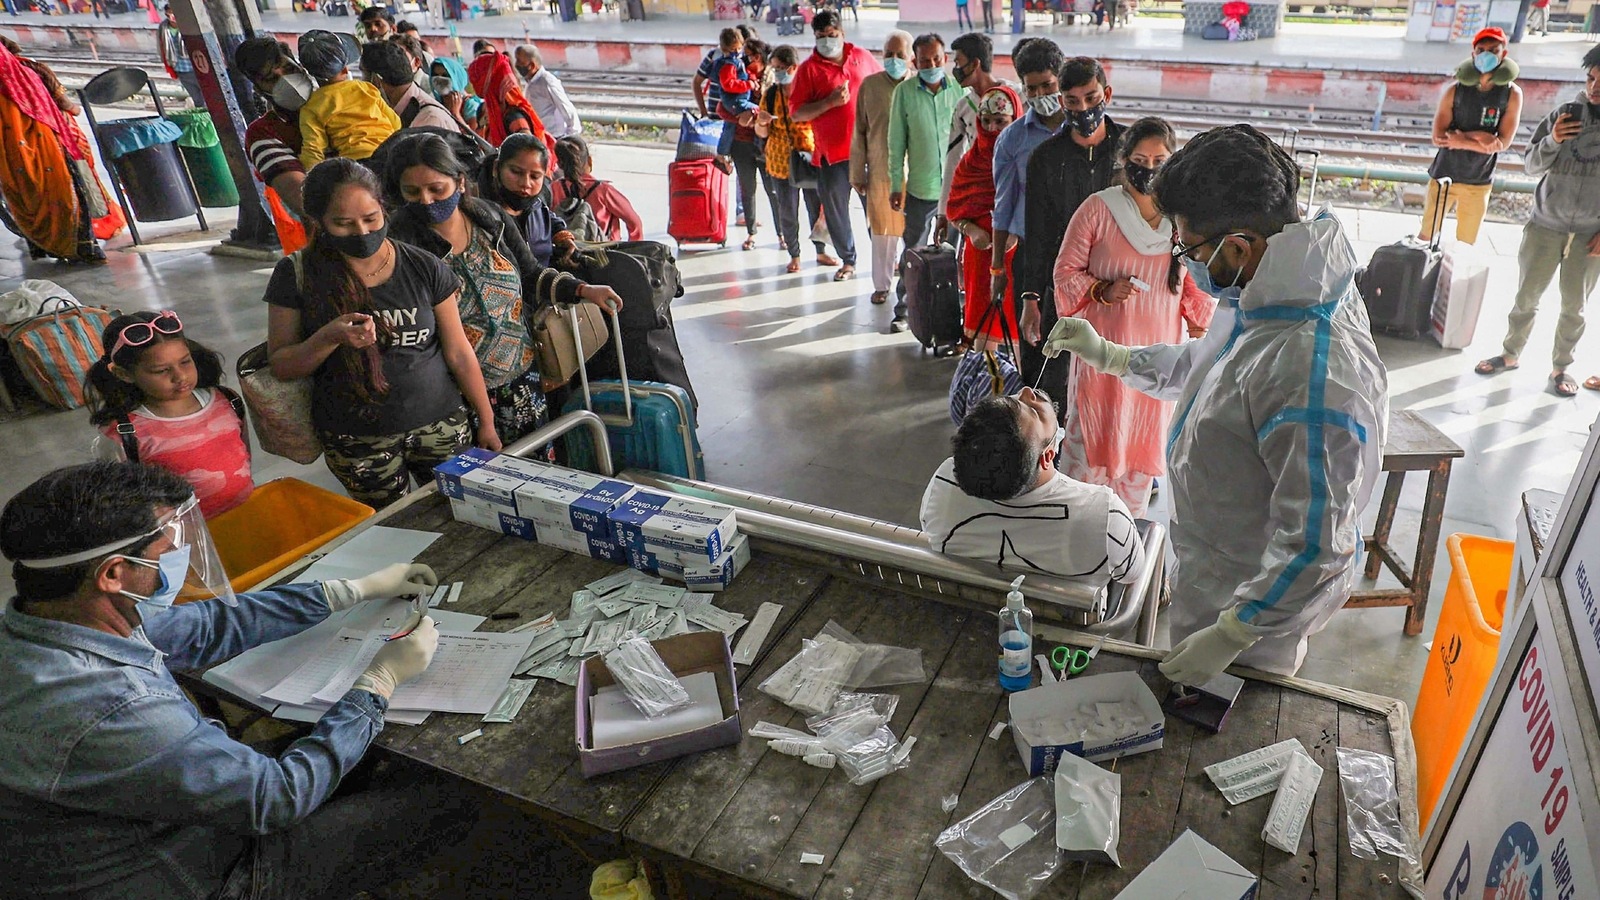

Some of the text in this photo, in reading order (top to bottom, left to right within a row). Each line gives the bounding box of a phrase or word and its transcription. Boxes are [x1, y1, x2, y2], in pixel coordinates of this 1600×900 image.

[627, 499, 660, 511] COVID-19
[629, 507, 646, 515] Ag
[502, 515, 525, 528] COVID-19
[573, 511, 598, 523] COVID-19
[510, 526, 522, 536] Ag
[582, 522, 594, 532] Ag
[615, 522, 627, 547] COVID-19
[627, 530, 635, 543] Ag
[591, 538, 615, 551] COVID-19
[599, 549, 611, 559] Ag
[641, 554, 649, 567] Ag
[1575, 560, 1595, 615] HEALTH
[1589, 607, 1598, 627] &
[1518, 646, 1575, 900] COVID 19 SAMPLE
